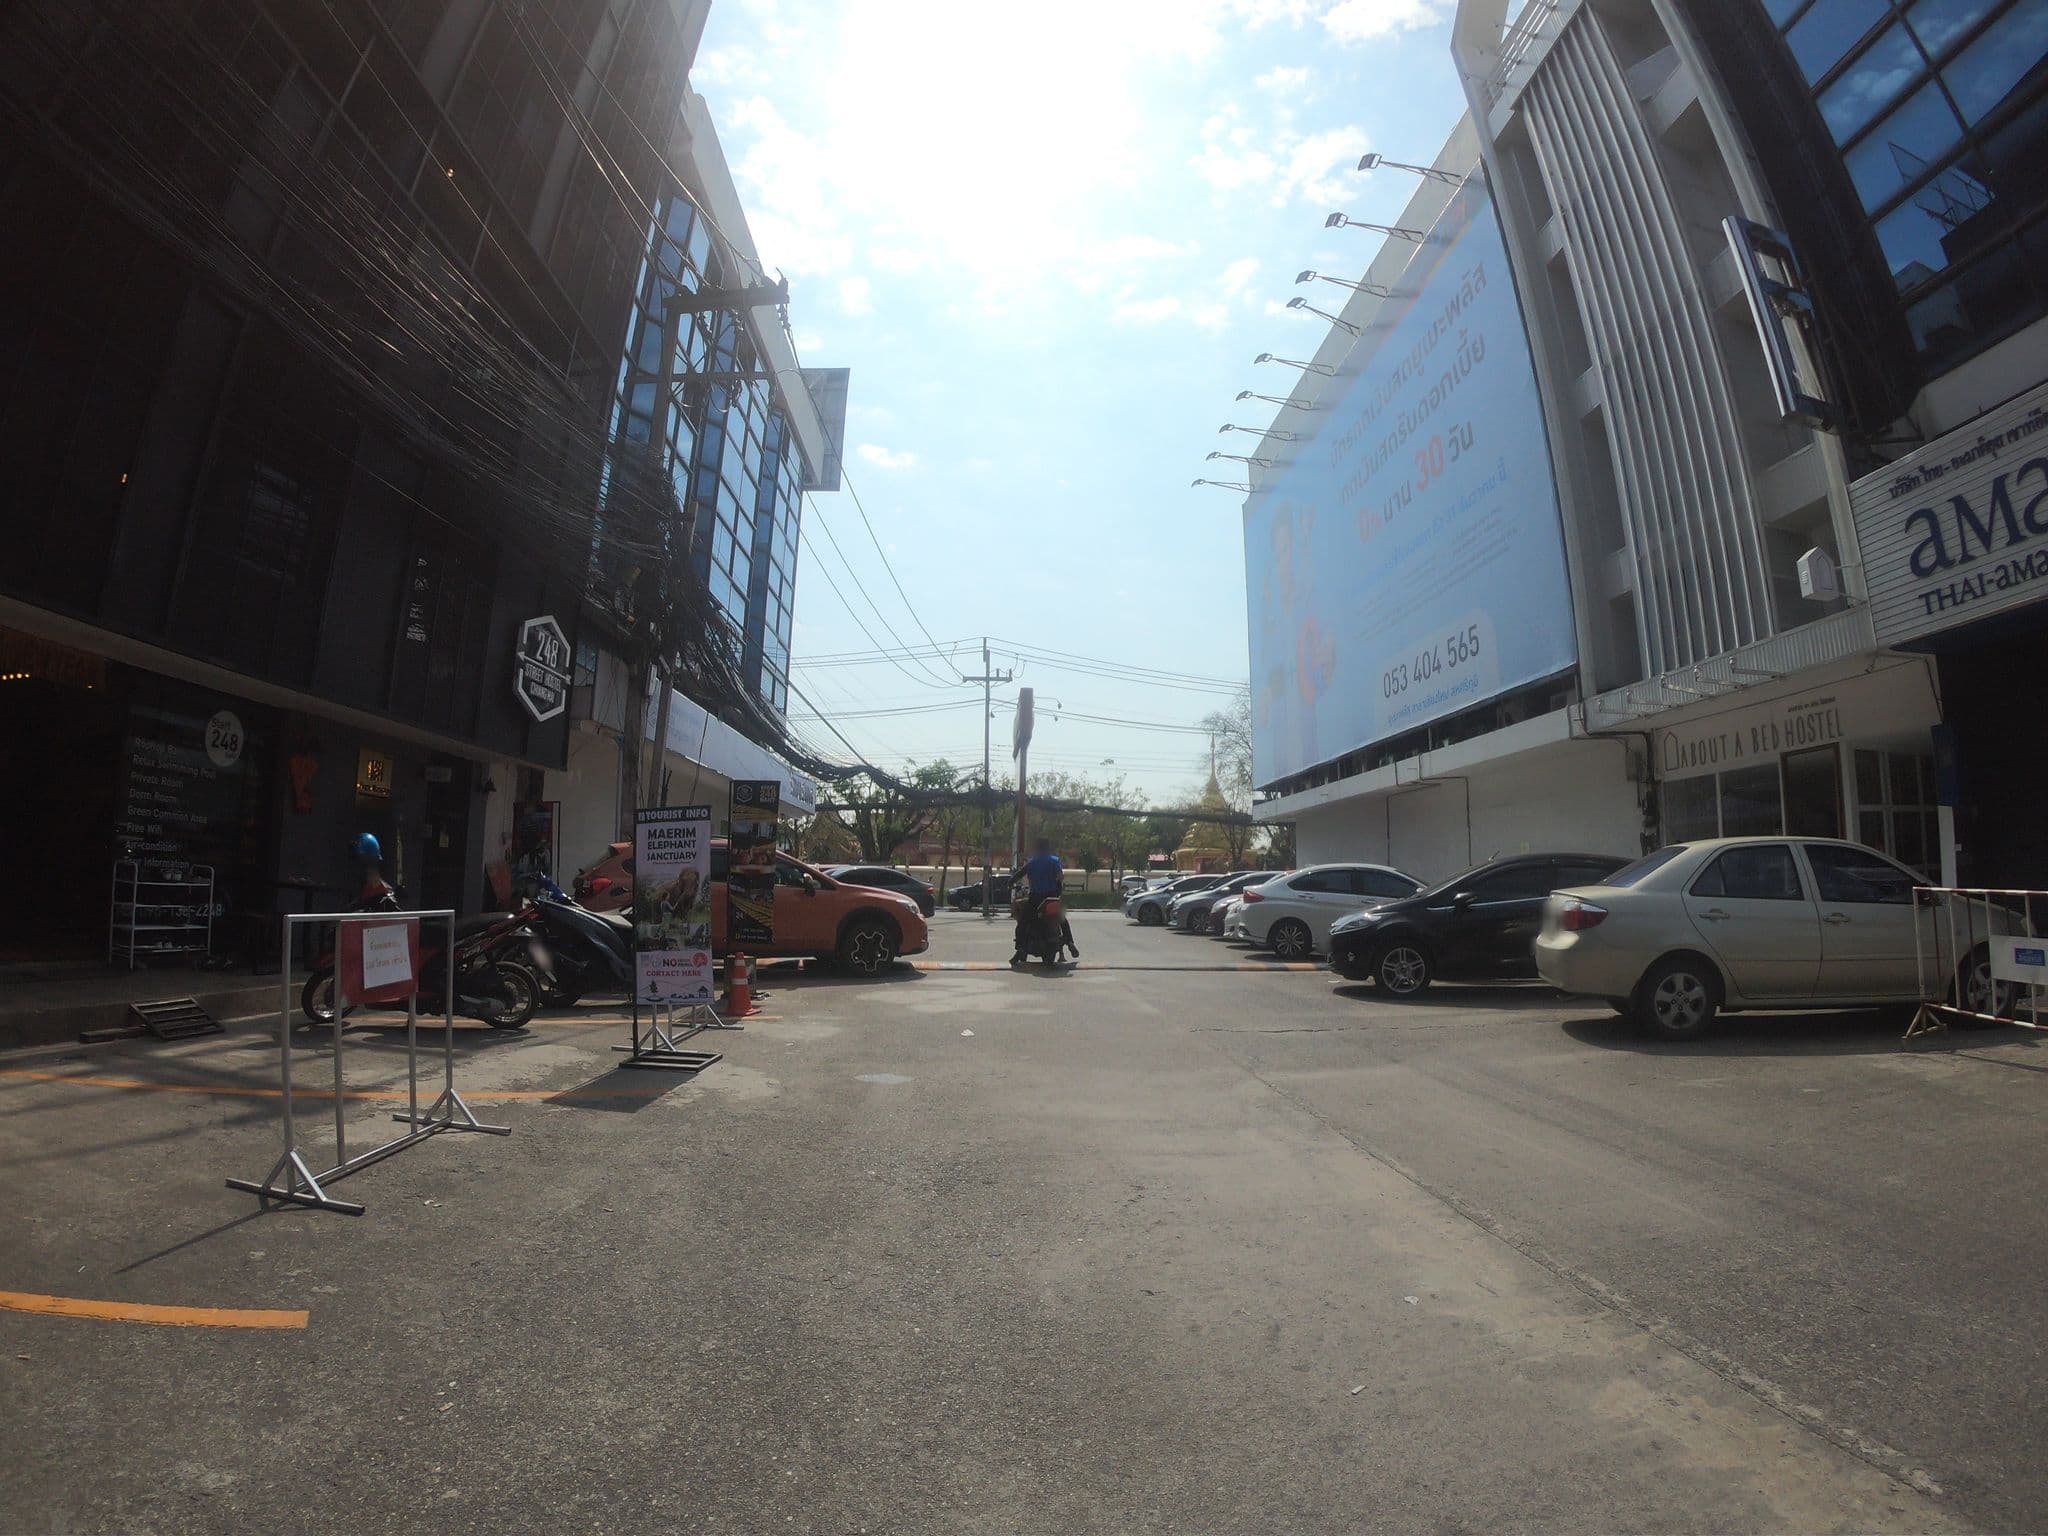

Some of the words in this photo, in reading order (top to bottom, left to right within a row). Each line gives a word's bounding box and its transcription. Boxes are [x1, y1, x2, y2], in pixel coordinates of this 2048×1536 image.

[1415, 434, 1444, 492] 30
[1448, 420, 1474, 463] วัน
[536, 630, 560, 668] 248
[1383, 664, 1408, 698] 053
[1413, 645, 1441, 683] 404
[1447, 624, 1480, 668] 565
[525, 663, 544, 684] STREET
[211, 729, 238, 752] 248
[1681, 735, 1727, 768] ABOUT
[1734, 732, 1744, 757] A
[1751, 722, 1779, 754] BED
[1784, 707, 1844, 748] HOSTEL
[130, 771, 159, 785] Private
[160, 776, 184, 789] Room
[129, 788, 152, 800] Dorm
[645, 810, 683, 821] TOURIST
[686, 808, 709, 818] INFO
[126, 821, 145, 833] Free
[648, 827, 697, 840] MAERIM
[648, 839, 697, 850] ELEPHANT
[647, 851, 697, 861] SANCTUARY
[662, 958, 677, 968] NO
[646, 969, 680, 977] CONTACT
